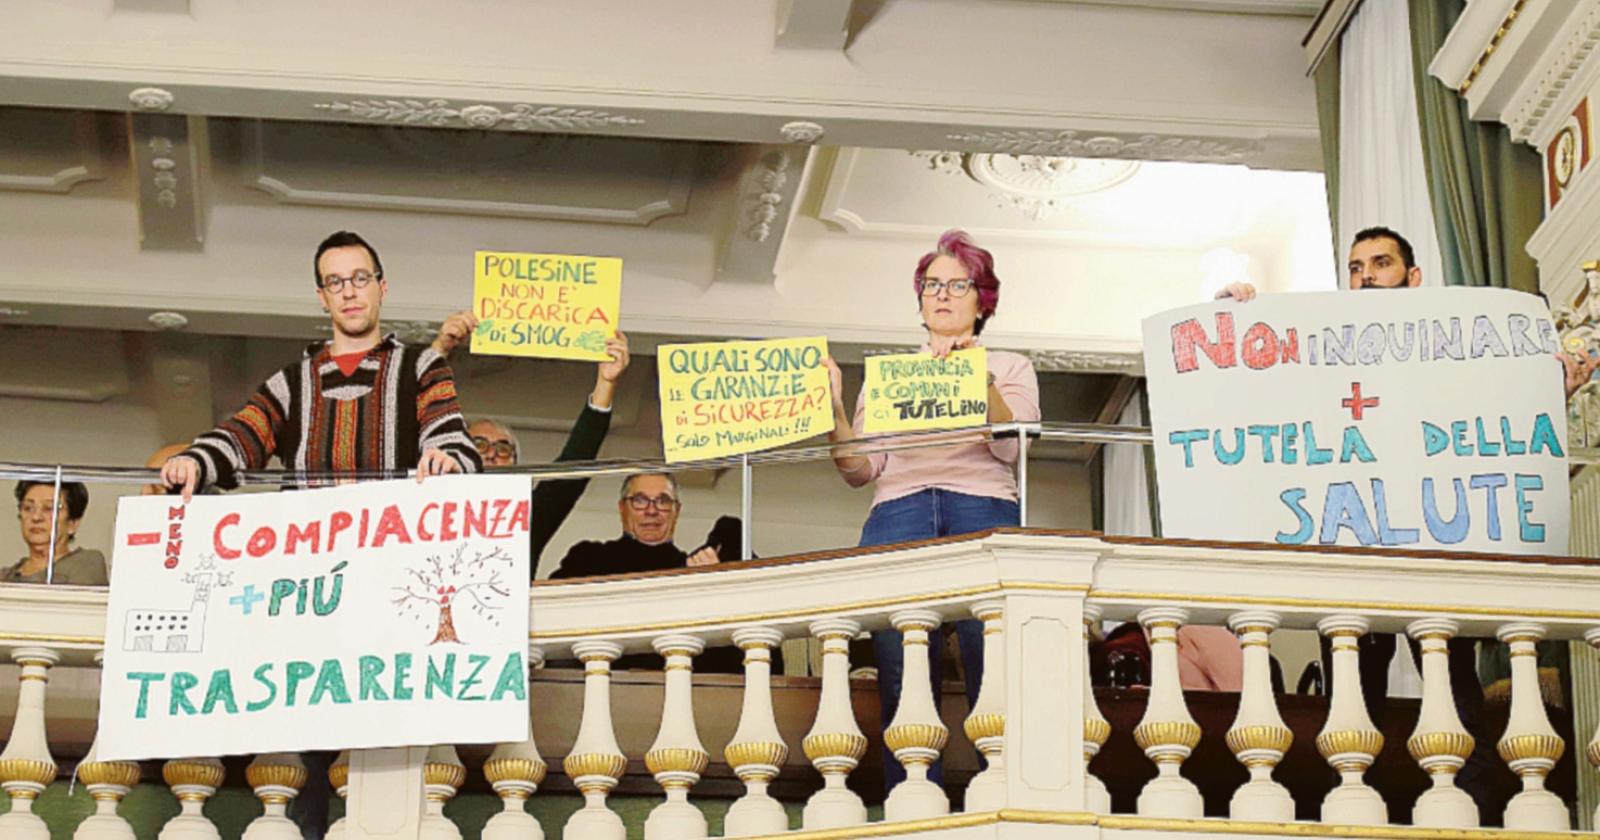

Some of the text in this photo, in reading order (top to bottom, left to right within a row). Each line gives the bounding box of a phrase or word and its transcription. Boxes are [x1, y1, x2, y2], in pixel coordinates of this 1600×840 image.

[484, 255, 598, 284] POLESiNE
[501, 283, 545, 300] NON
[481, 297, 609, 325] DiSCARiCA
[511, 321, 571, 348] SMOG
[1307, 313, 1560, 366] INQUINARE
[669, 345, 822, 374] QUALi SONO
[690, 373, 806, 400] GARANZiE
[693, 386, 827, 427] SiCUREZZA?
[893, 398, 987, 420] TUTELiNO
[1169, 413, 1565, 468] TUTELA DELLA
[1275, 473, 1546, 546] SALUTE
[164, 505, 186, 569] MENO
[213, 499, 530, 560] COMPIACENZA
[126, 651, 526, 719] TRASPARENZA
